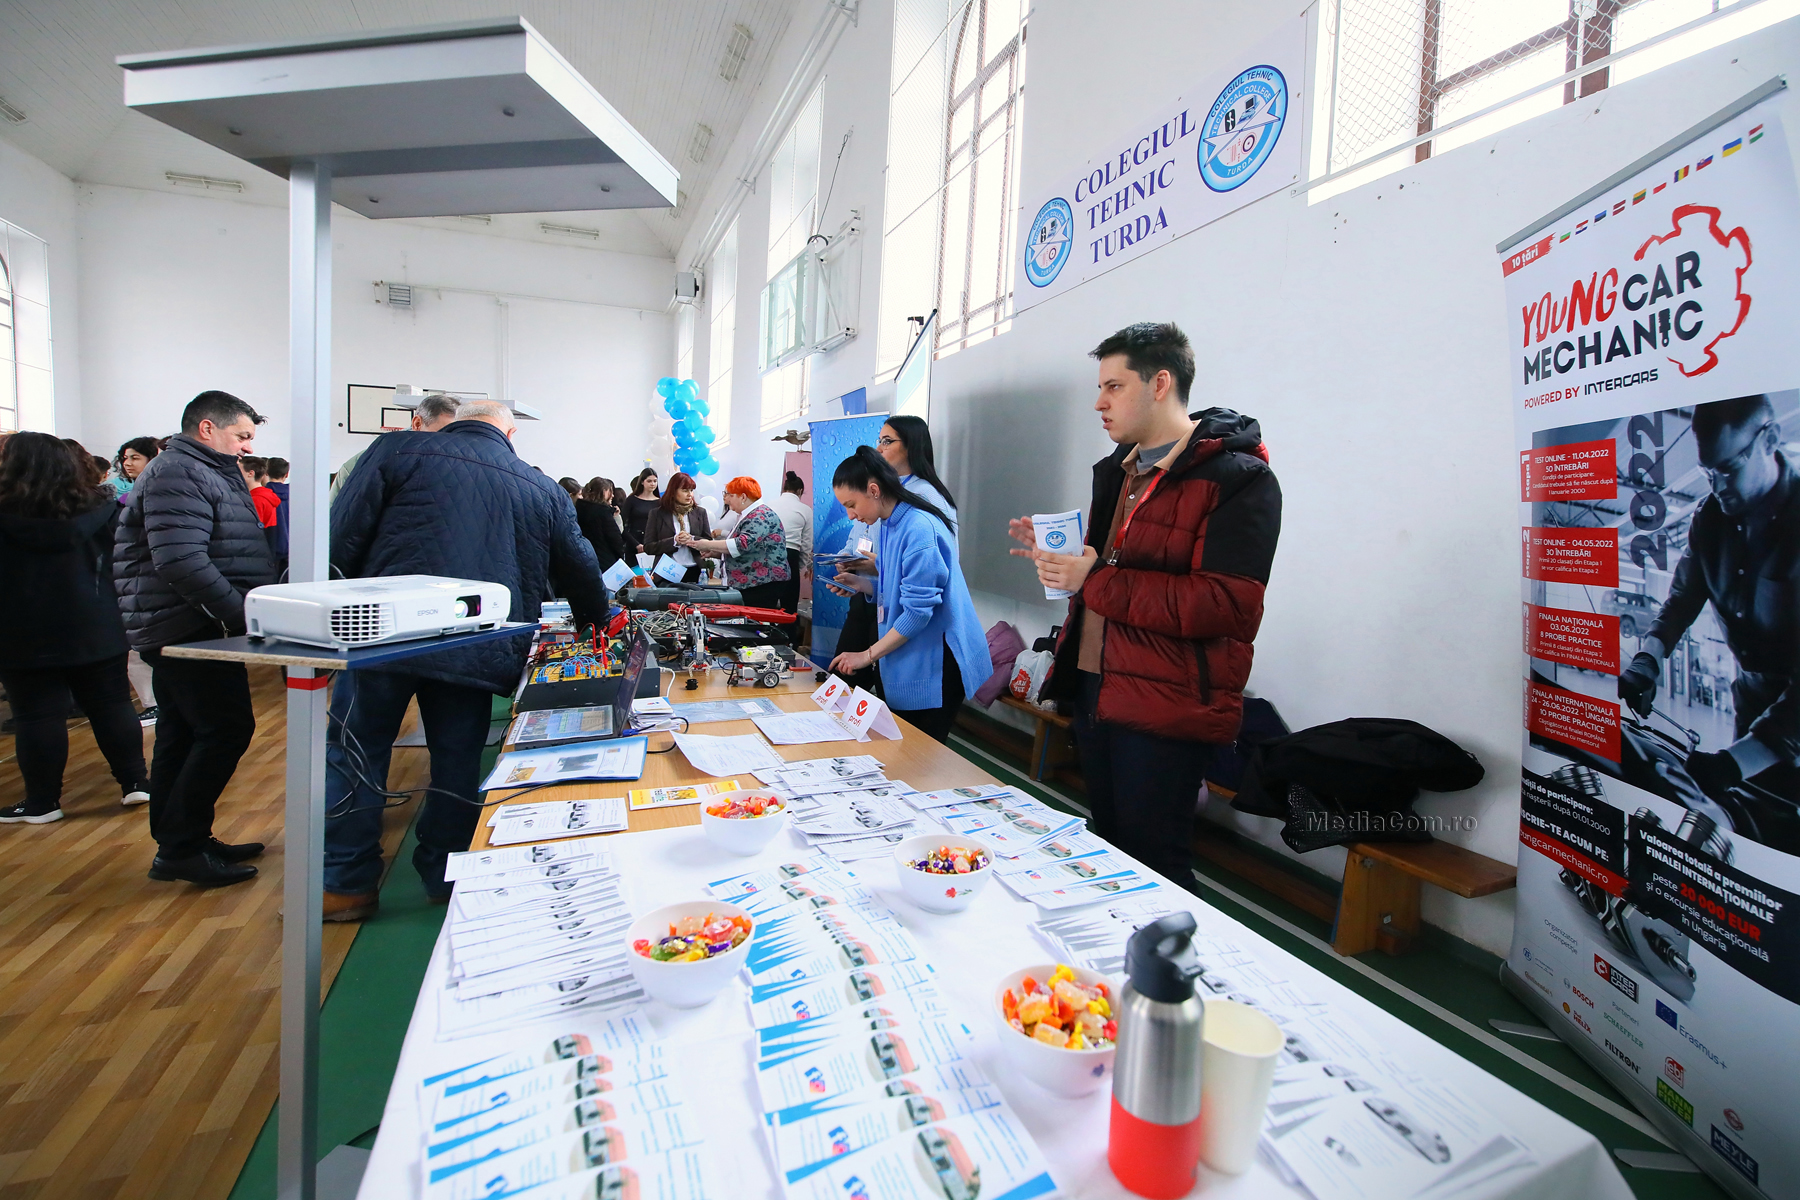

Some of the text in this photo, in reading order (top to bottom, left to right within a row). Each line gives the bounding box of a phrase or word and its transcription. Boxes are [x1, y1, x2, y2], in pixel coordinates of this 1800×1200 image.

[1211, 70, 1273, 118] COLEGIUL TEHNIC
[1212, 85, 1272, 135] TECHNICAL COLLEGE
[1075, 108, 1196, 203] COLEGIUL
[1227, 157, 1253, 176] TURDA
[1086, 159, 1175, 230] TEHNIC
[1090, 206, 1168, 264] TURDA
[1512, 257, 1521, 269] 10
[1623, 250, 1702, 312] CAR
[1524, 300, 1703, 385] MECHANIC
[1525, 368, 1659, 409] POWERED BY INTERCARS
[1545, 454, 1566, 463] ONLINE
[1572, 449, 1609, 460] 11.04.2022
[1554, 462, 1589, 472] ÎNTREBĂRI
[1627, 411, 1667, 571] 2022
[1556, 548, 1591, 557] ÎNTREBĂRI
[1572, 540, 1614, 548] 04.05.2022
[1539, 613, 1604, 629] FINALA NAȚIONALĂ
[1550, 623, 1590, 635] 03.06.2022
[1545, 632, 1567, 642] PROBE
[1568, 637, 1602, 648] PRACTICE
[1566, 653, 1584, 662] FINALA
[816, 696, 829, 706] profi
[1532, 696, 1538, 704] 24
[1542, 700, 1579, 716] 26.06.2022
[1585, 712, 1617, 728] UNGARIA
[1533, 688, 1615, 717] FINALA INTERNAȚIONALĂ
[848, 715, 862, 728] profi
[1548, 711, 1571, 724] PROBE
[1573, 718, 1605, 734] PRACTICE
[1537, 785, 1546, 794] de
[1547, 790, 1593, 815] participare:
[1553, 803, 1571, 817] după
[1572, 812, 1610, 836] 01.01.2000
[1563, 830, 1592, 853] ACUM
[1595, 846, 1609, 862] PE:
[1639, 830, 1783, 911] Valoarea totală a premiilor
[1646, 846, 1775, 924] FINALEI INTERNAȚIONALE
[1653, 873, 1761, 942] peste 20 000 EUR
[1655, 887, 1662, 896] o
[1663, 892, 1700, 920] excursie
[1702, 916, 1770, 963] educațională
[1682, 914, 1728, 952] în Ungaria
[1611, 968, 1635, 989] INTER
[1611, 976, 1635, 999] CARS
[1573, 986, 1594, 1009] BOSCH
[1604, 1012, 1644, 1049] SCHAEFFLER
[1604, 1038, 1639, 1074] FILTRON
[1680, 1024, 1728, 1070] Erasmus+
[1658, 1081, 1694, 1113] MANN
[1658, 1092, 1692, 1124] FILTER
[1714, 1131, 1754, 1173] MEYLE
